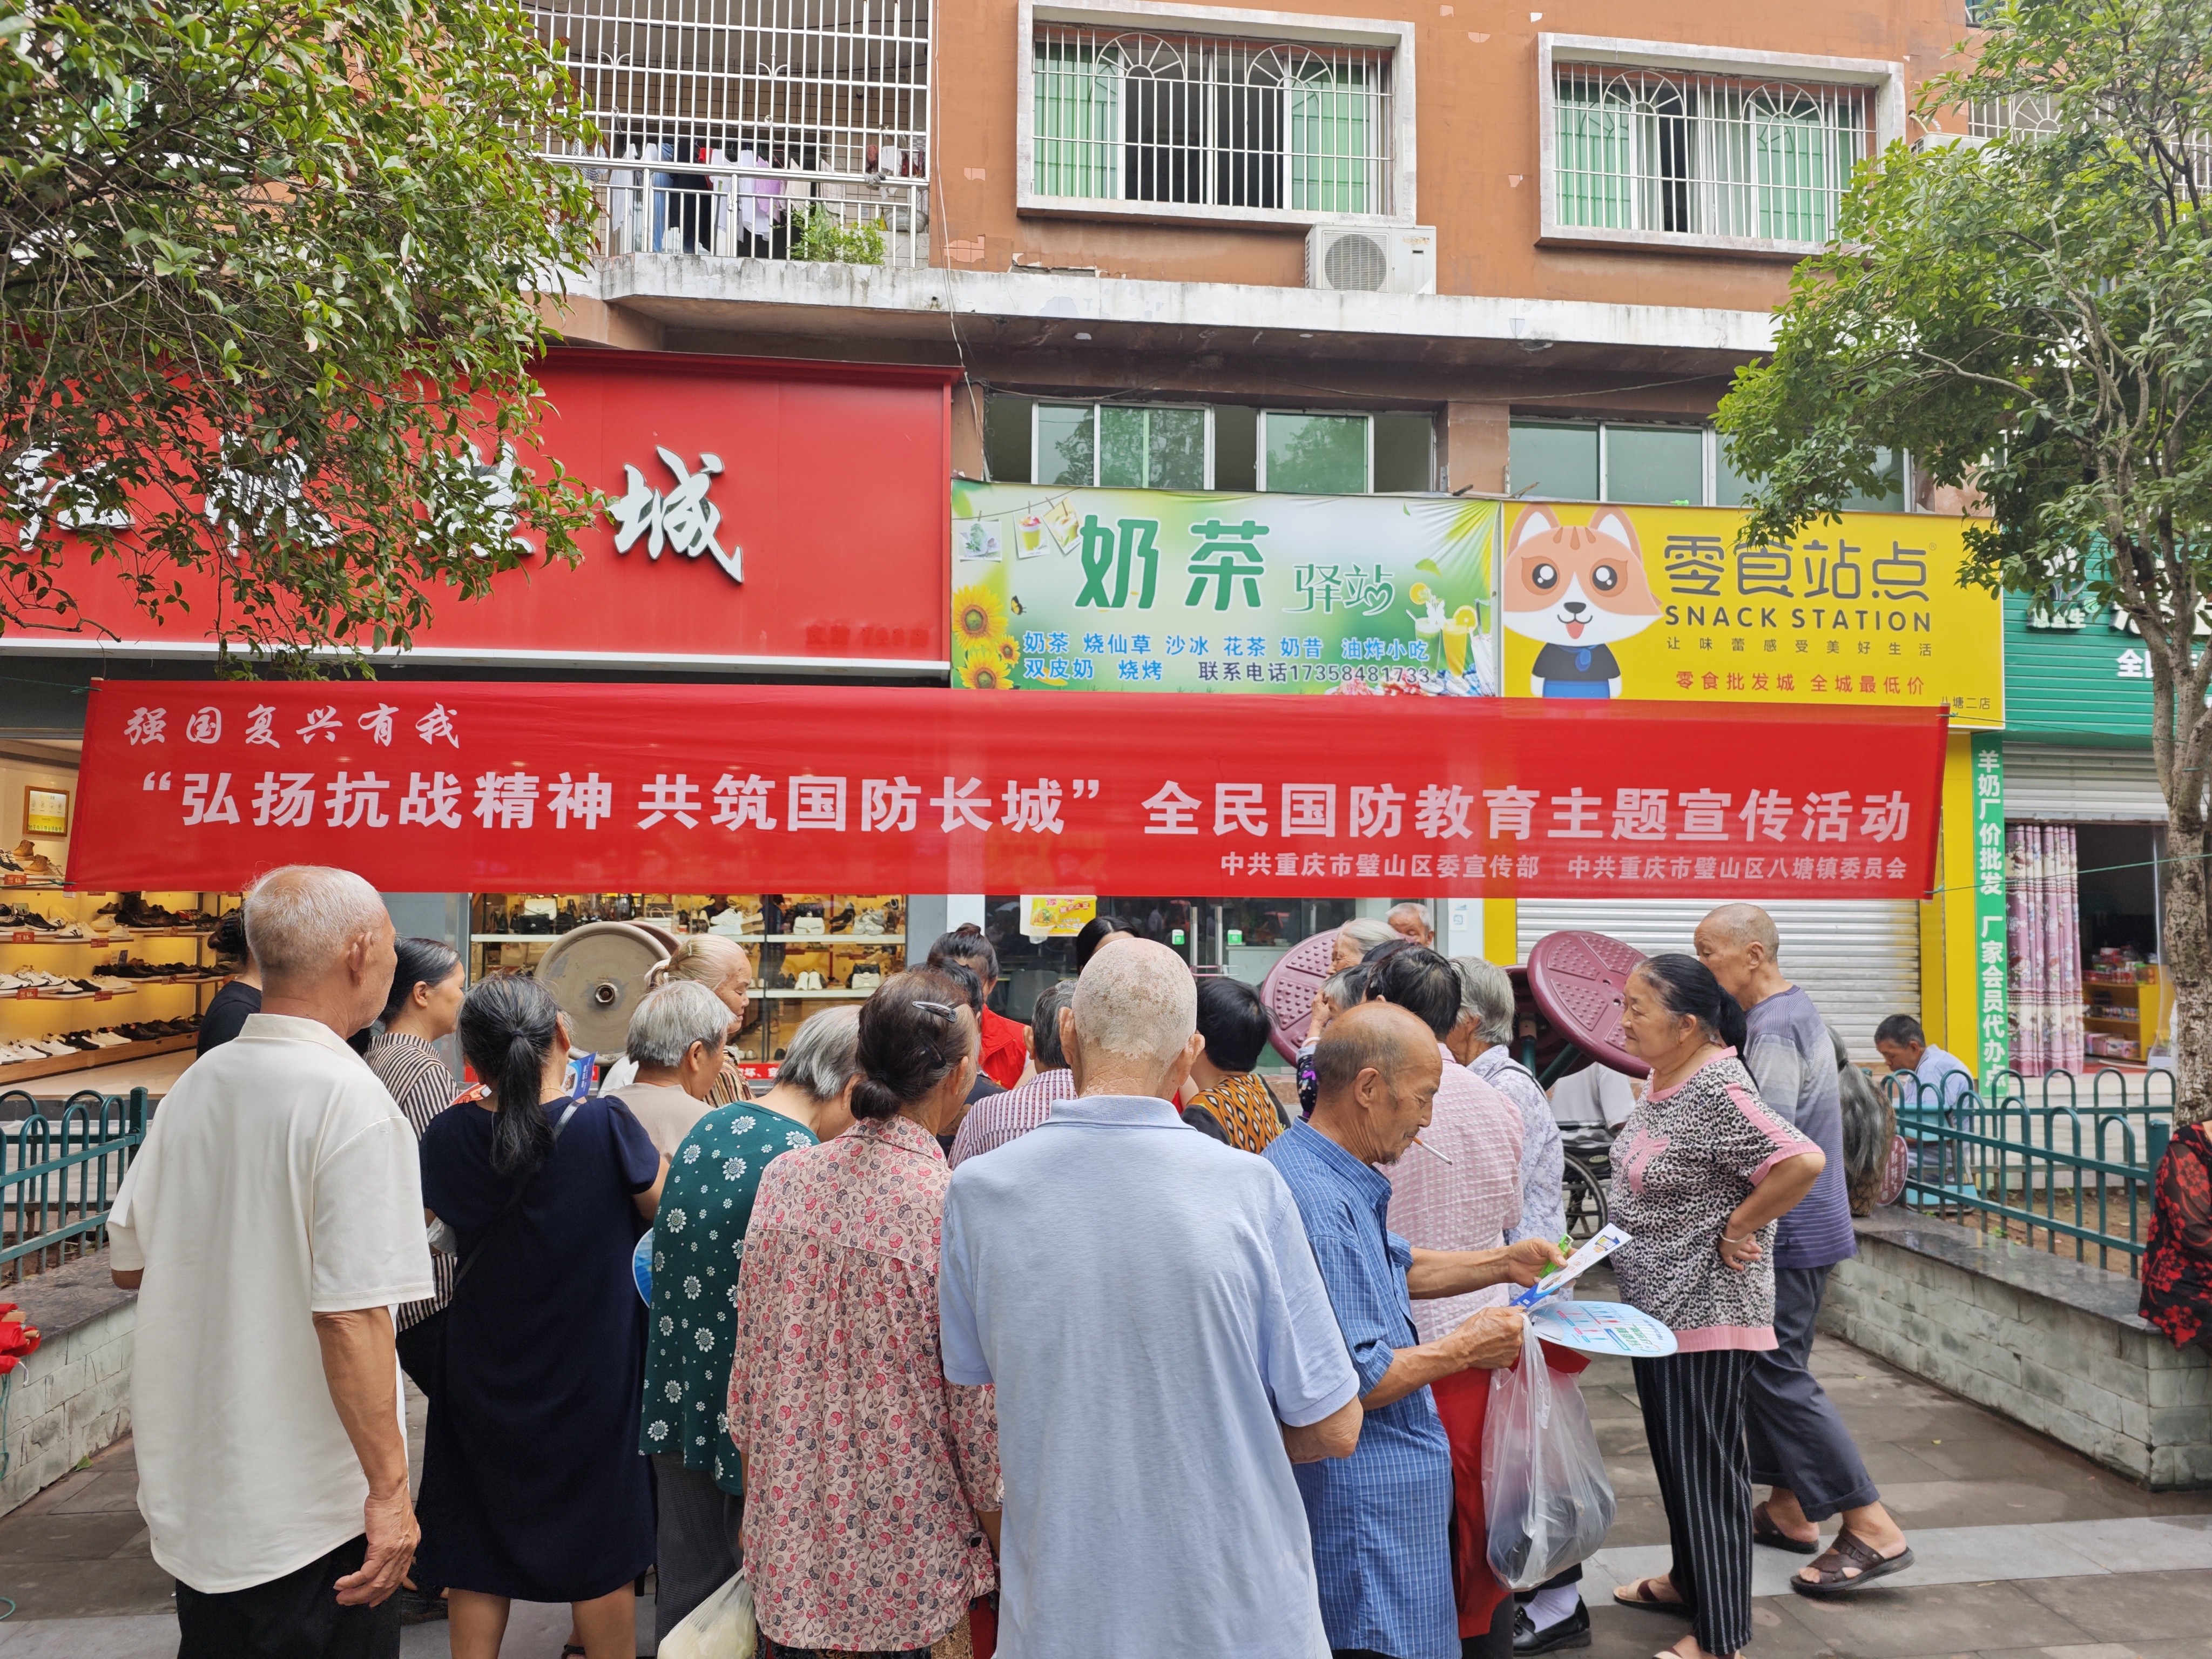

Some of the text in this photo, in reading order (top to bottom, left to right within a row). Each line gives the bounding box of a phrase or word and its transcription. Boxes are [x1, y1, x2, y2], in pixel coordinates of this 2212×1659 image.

[1075, 515, 1393, 615] 奶茶 驿站
[1664, 535, 1930, 602] 零食站点
[1665, 605, 1931, 632] SNACK STATION
[1024, 632, 1429, 660] 奶茶 烧仙草 沙冰 花茶 奶昔 油炸小吃
[1667, 636, 1932, 657] 让味蕾感受美好生活
[1024, 658, 1430, 684] 双皮奶 烧烤 联系电话17358481733
[1676, 671, 1925, 696] 零食批发城 全城最低价
[124, 703, 459, 748] 强国复兴有我
[143, 771, 1910, 842] “弘扬抗战精神 共筑国防长城” 全民国防教育主题宣传活动
[1221, 852, 1907, 880] 中共重庆市璧山区委宣传部 中共重庆市璧山区八塘镇委员会
[1978, 750, 2006, 1088] 羊奶厂价批发 厂家会员代办点
